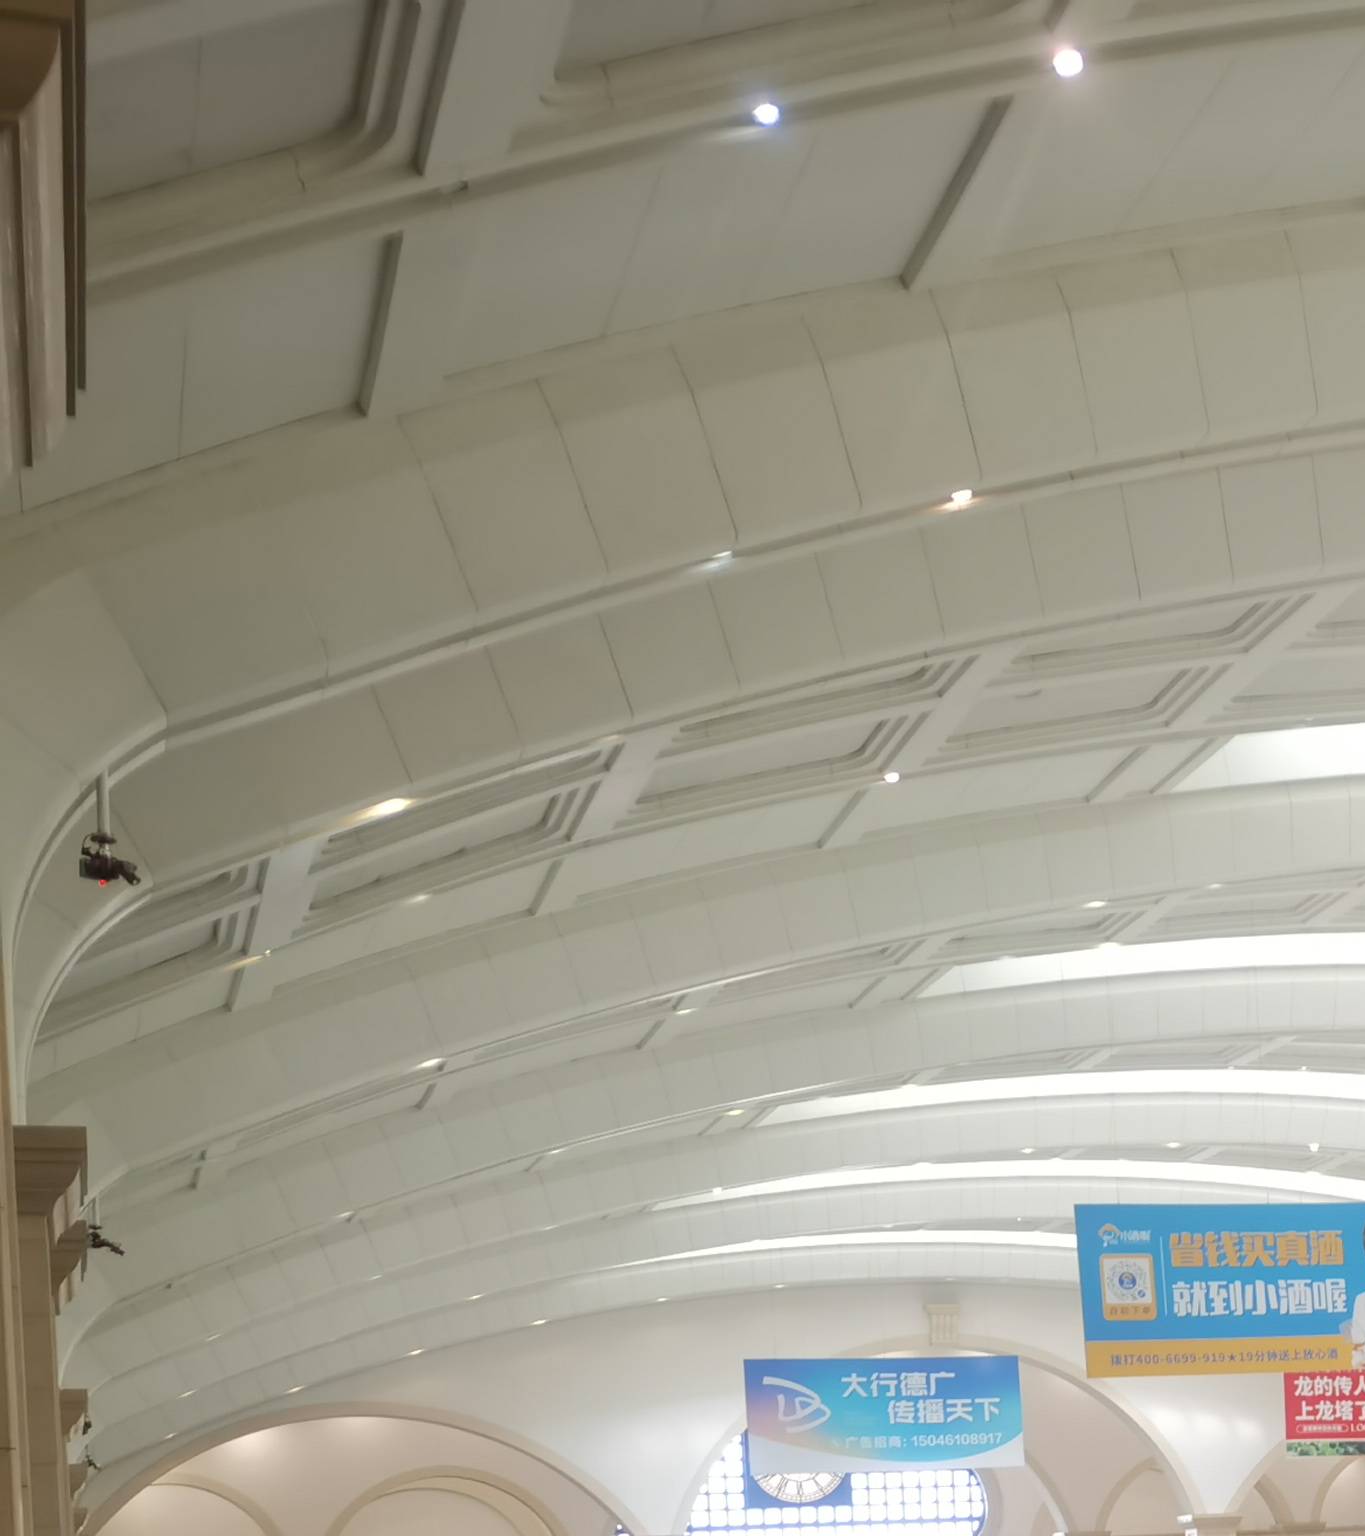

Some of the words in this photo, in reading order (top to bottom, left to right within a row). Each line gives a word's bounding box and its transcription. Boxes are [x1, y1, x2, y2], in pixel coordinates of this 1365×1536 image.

[1169, 1231, 1344, 1269] 省钱买真酒
[1171, 1278, 1348, 1317] 就到小酒喔
[840, 1371, 956, 1399] 大行德广
[886, 1396, 1002, 1425] 传播天下
[911, 1432, 1003, 1447] 15046108917
